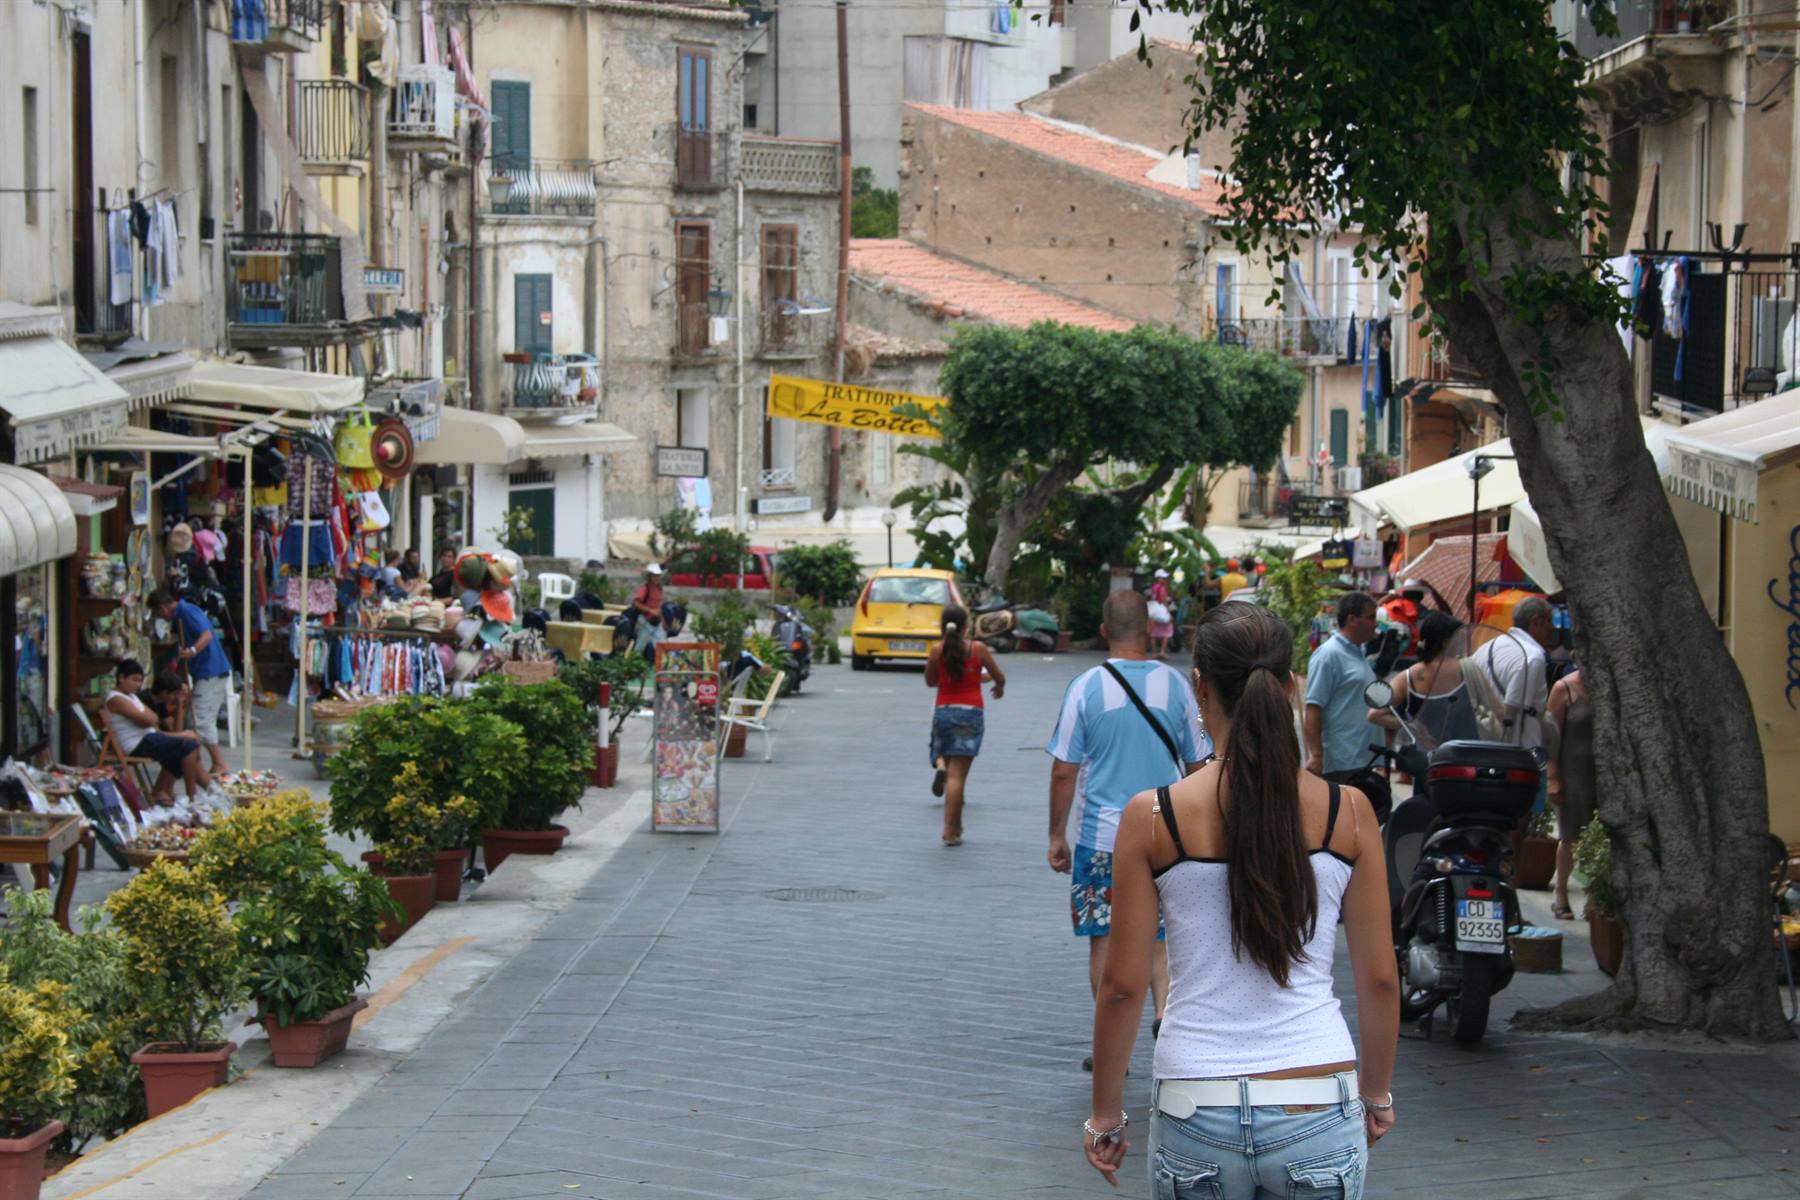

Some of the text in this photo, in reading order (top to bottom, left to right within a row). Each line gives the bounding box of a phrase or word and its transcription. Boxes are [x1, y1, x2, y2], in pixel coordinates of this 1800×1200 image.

[800, 400, 923, 433] La Botte
[1459, 921, 1502, 939] 92335
